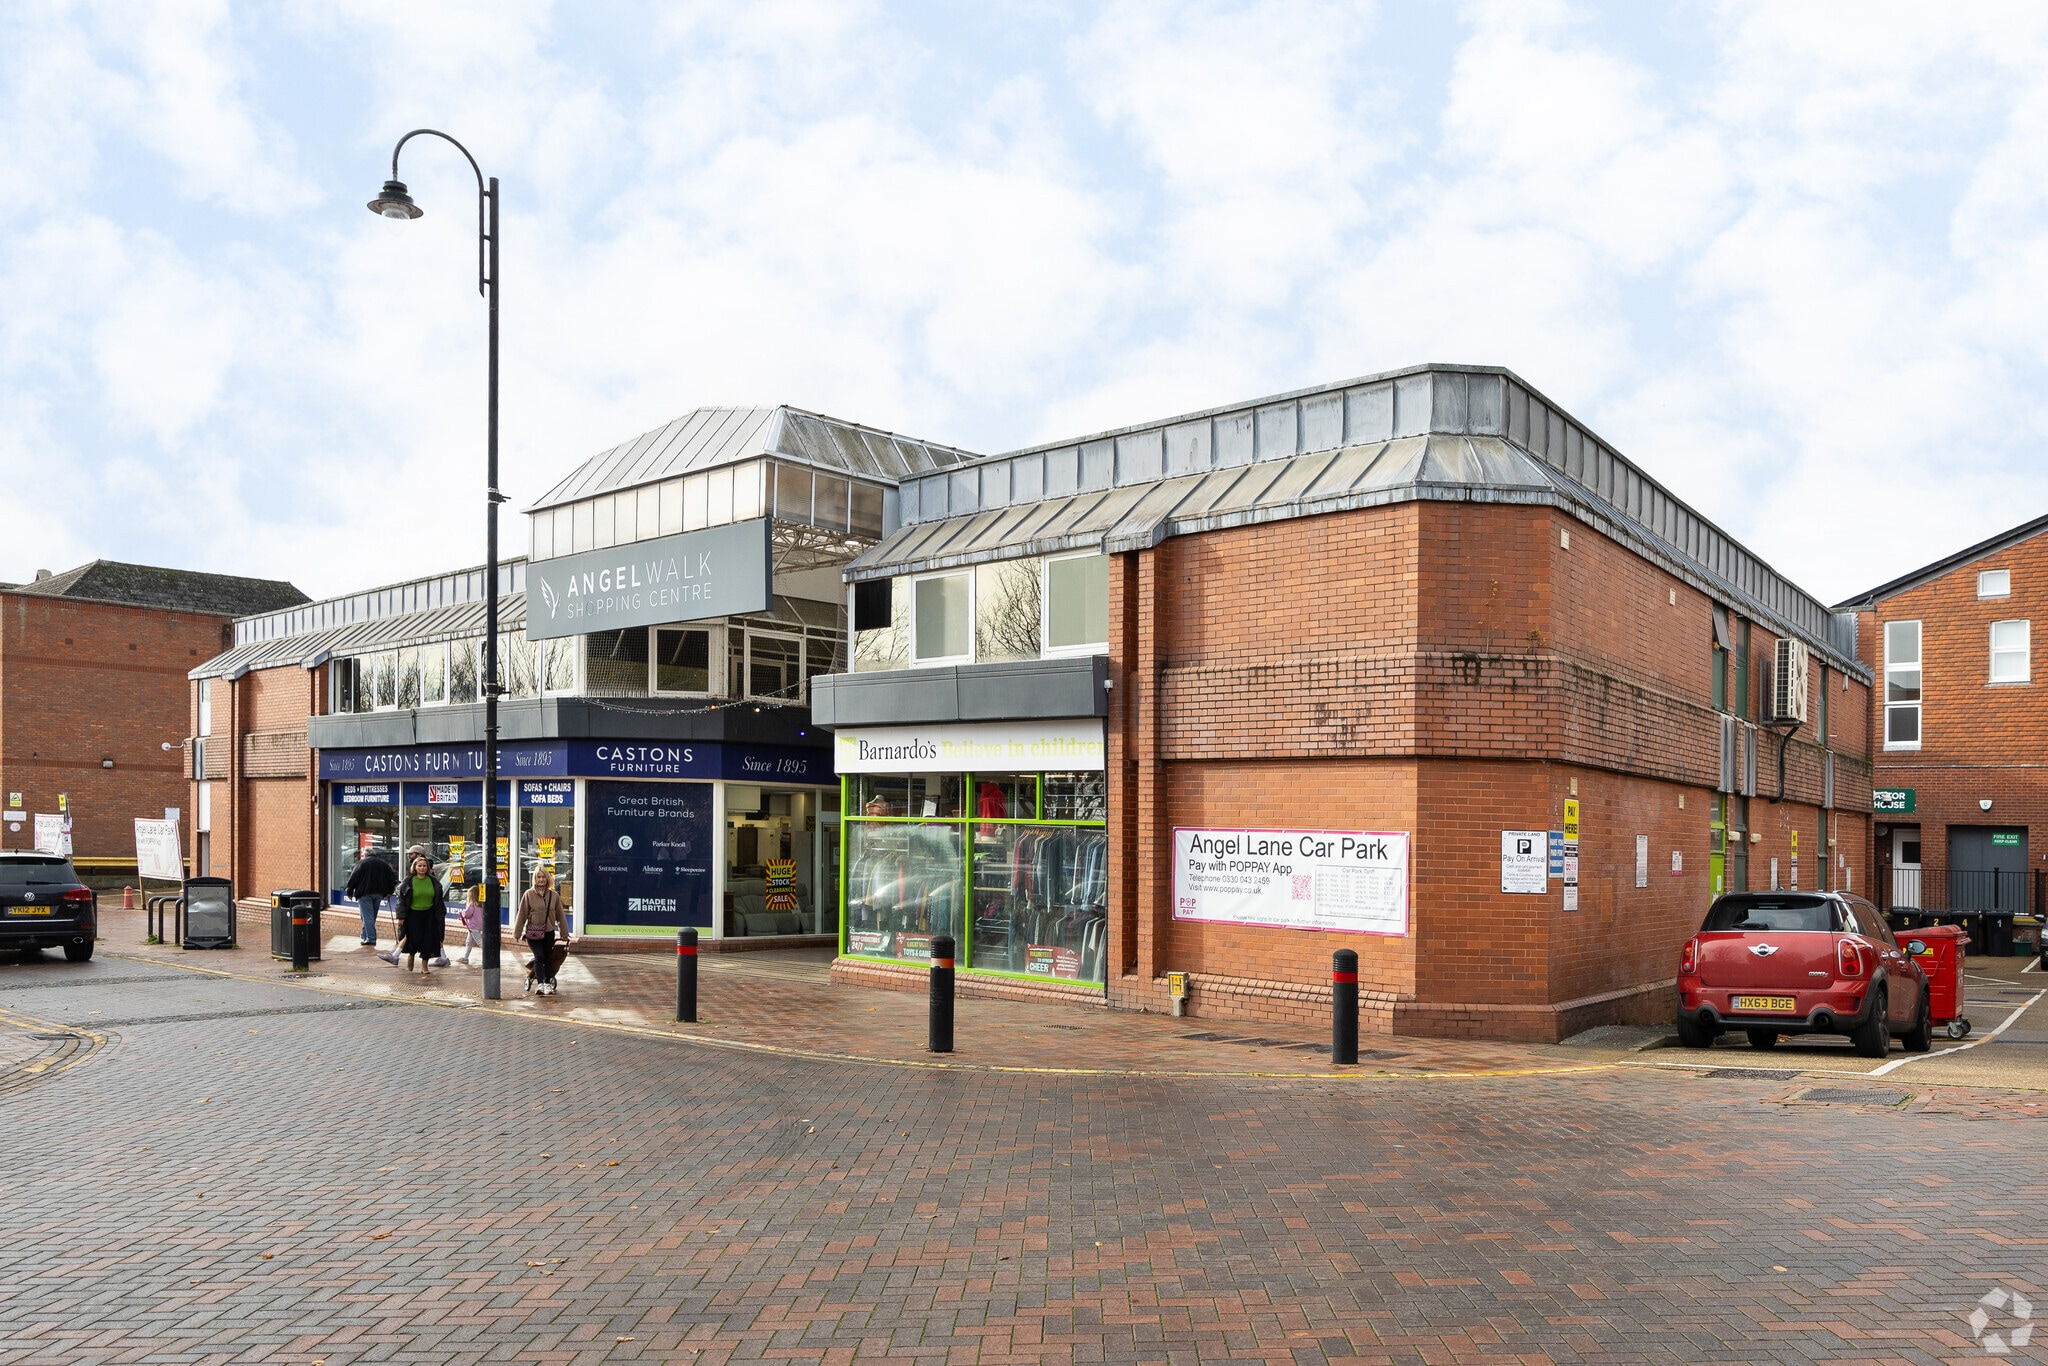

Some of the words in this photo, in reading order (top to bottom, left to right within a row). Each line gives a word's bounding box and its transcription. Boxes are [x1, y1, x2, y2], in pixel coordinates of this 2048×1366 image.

[567, 593, 641, 619] SHOPPING
[650, 582, 712, 607] CENTRE
[596, 746, 694, 763] CASTONS
[858, 738, 937, 761] Barnardo's
[941, 740, 1003, 759] Believe
[1008, 739, 1025, 758] in
[329, 758, 341, 771] Since
[341, 758, 355, 771] 1895
[364, 753, 420, 773] CASTONS
[425, 750, 502, 771] FURNITUE
[515, 752, 532, 767] Since
[533, 751, 553, 766] 1895
[742, 756, 772, 772] Since
[775, 758, 808, 774] 1895
[610, 762, 680, 773] FURNITURE
[344, 785, 356, 794] BEDS
[359, 784, 389, 793] MATTRESSES
[436, 785, 451, 794] MADE
[451, 785, 457, 793] IN
[523, 783, 543, 792] SOFAS
[548, 783, 572, 792] CHAIRS
[364, 794, 390, 803] FURNITURE
[436, 793, 457, 802] BRITAIN
[530, 794, 547, 803] SOFA
[547, 794, 564, 803] BEDS
[618, 795, 648, 805] Great
[651, 796, 685, 806] British
[607, 807, 655, 817] Furniture
[657, 808, 695, 819] Brands
[1189, 833, 1240, 860] Angel
[1247, 834, 1293, 856] Lane
[1299, 835, 1335, 858] Car
[1341, 837, 1389, 860] Park
[1503, 854, 1515, 864] Pay
[1516, 854, 1526, 863] On
[1526, 855, 1546, 863] Arrival
[771, 867, 791, 876] HUGE
[1188, 859, 1207, 873] Pay
[1208, 860, 1227, 872] with
[1229, 860, 1271, 874] POPPAY
[1272, 862, 1293, 876] App
[1188, 873, 1221, 885] Telephone
[1222, 875, 1239, 883] 0330
[1239, 876, 1252, 884] 043
[1253, 876, 1270, 885] 2459
[769, 886, 794, 894] CLEARANCE
[1188, 883, 1202, 891] Visit
[1203, 886, 1262, 895] www.poppay.co.uk
[773, 895, 789, 903] SALE
[12, 906, 30, 914] YK12
[31, 906, 46, 914] JYX
[1903, 917, 1910, 926] 3
[1933, 918, 1940, 927] 2
[1962, 918, 1968, 928] 4
[1996, 919, 2002, 928] 1
[851, 942, 864, 951] 24/7
[903, 948, 914, 956] TOYS
[1030, 962, 1049, 972] CHEER
[1740, 997, 1769, 1008] HX63
[1771, 998, 1793, 1009] BGE
